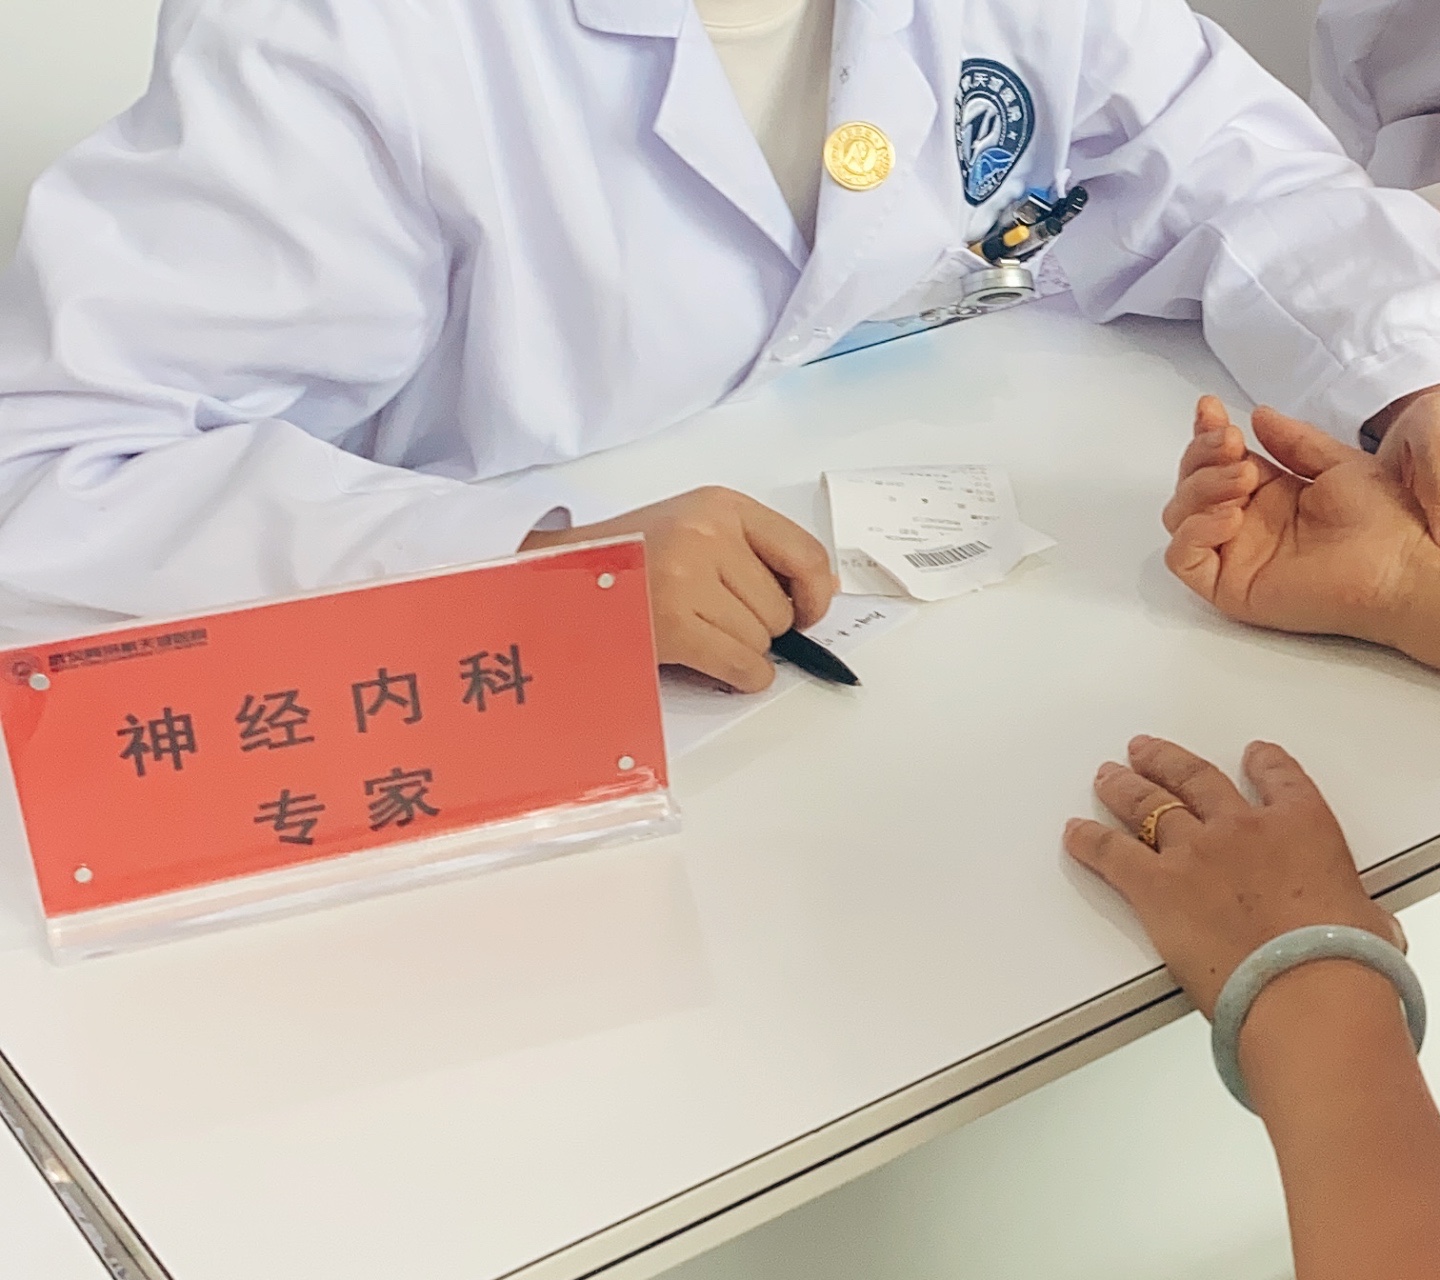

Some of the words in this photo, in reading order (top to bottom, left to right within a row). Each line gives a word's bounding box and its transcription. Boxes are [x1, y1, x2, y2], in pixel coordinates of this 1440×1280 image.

[117, 643, 532, 777] 神经内科
[254, 767, 440, 846] 专家
